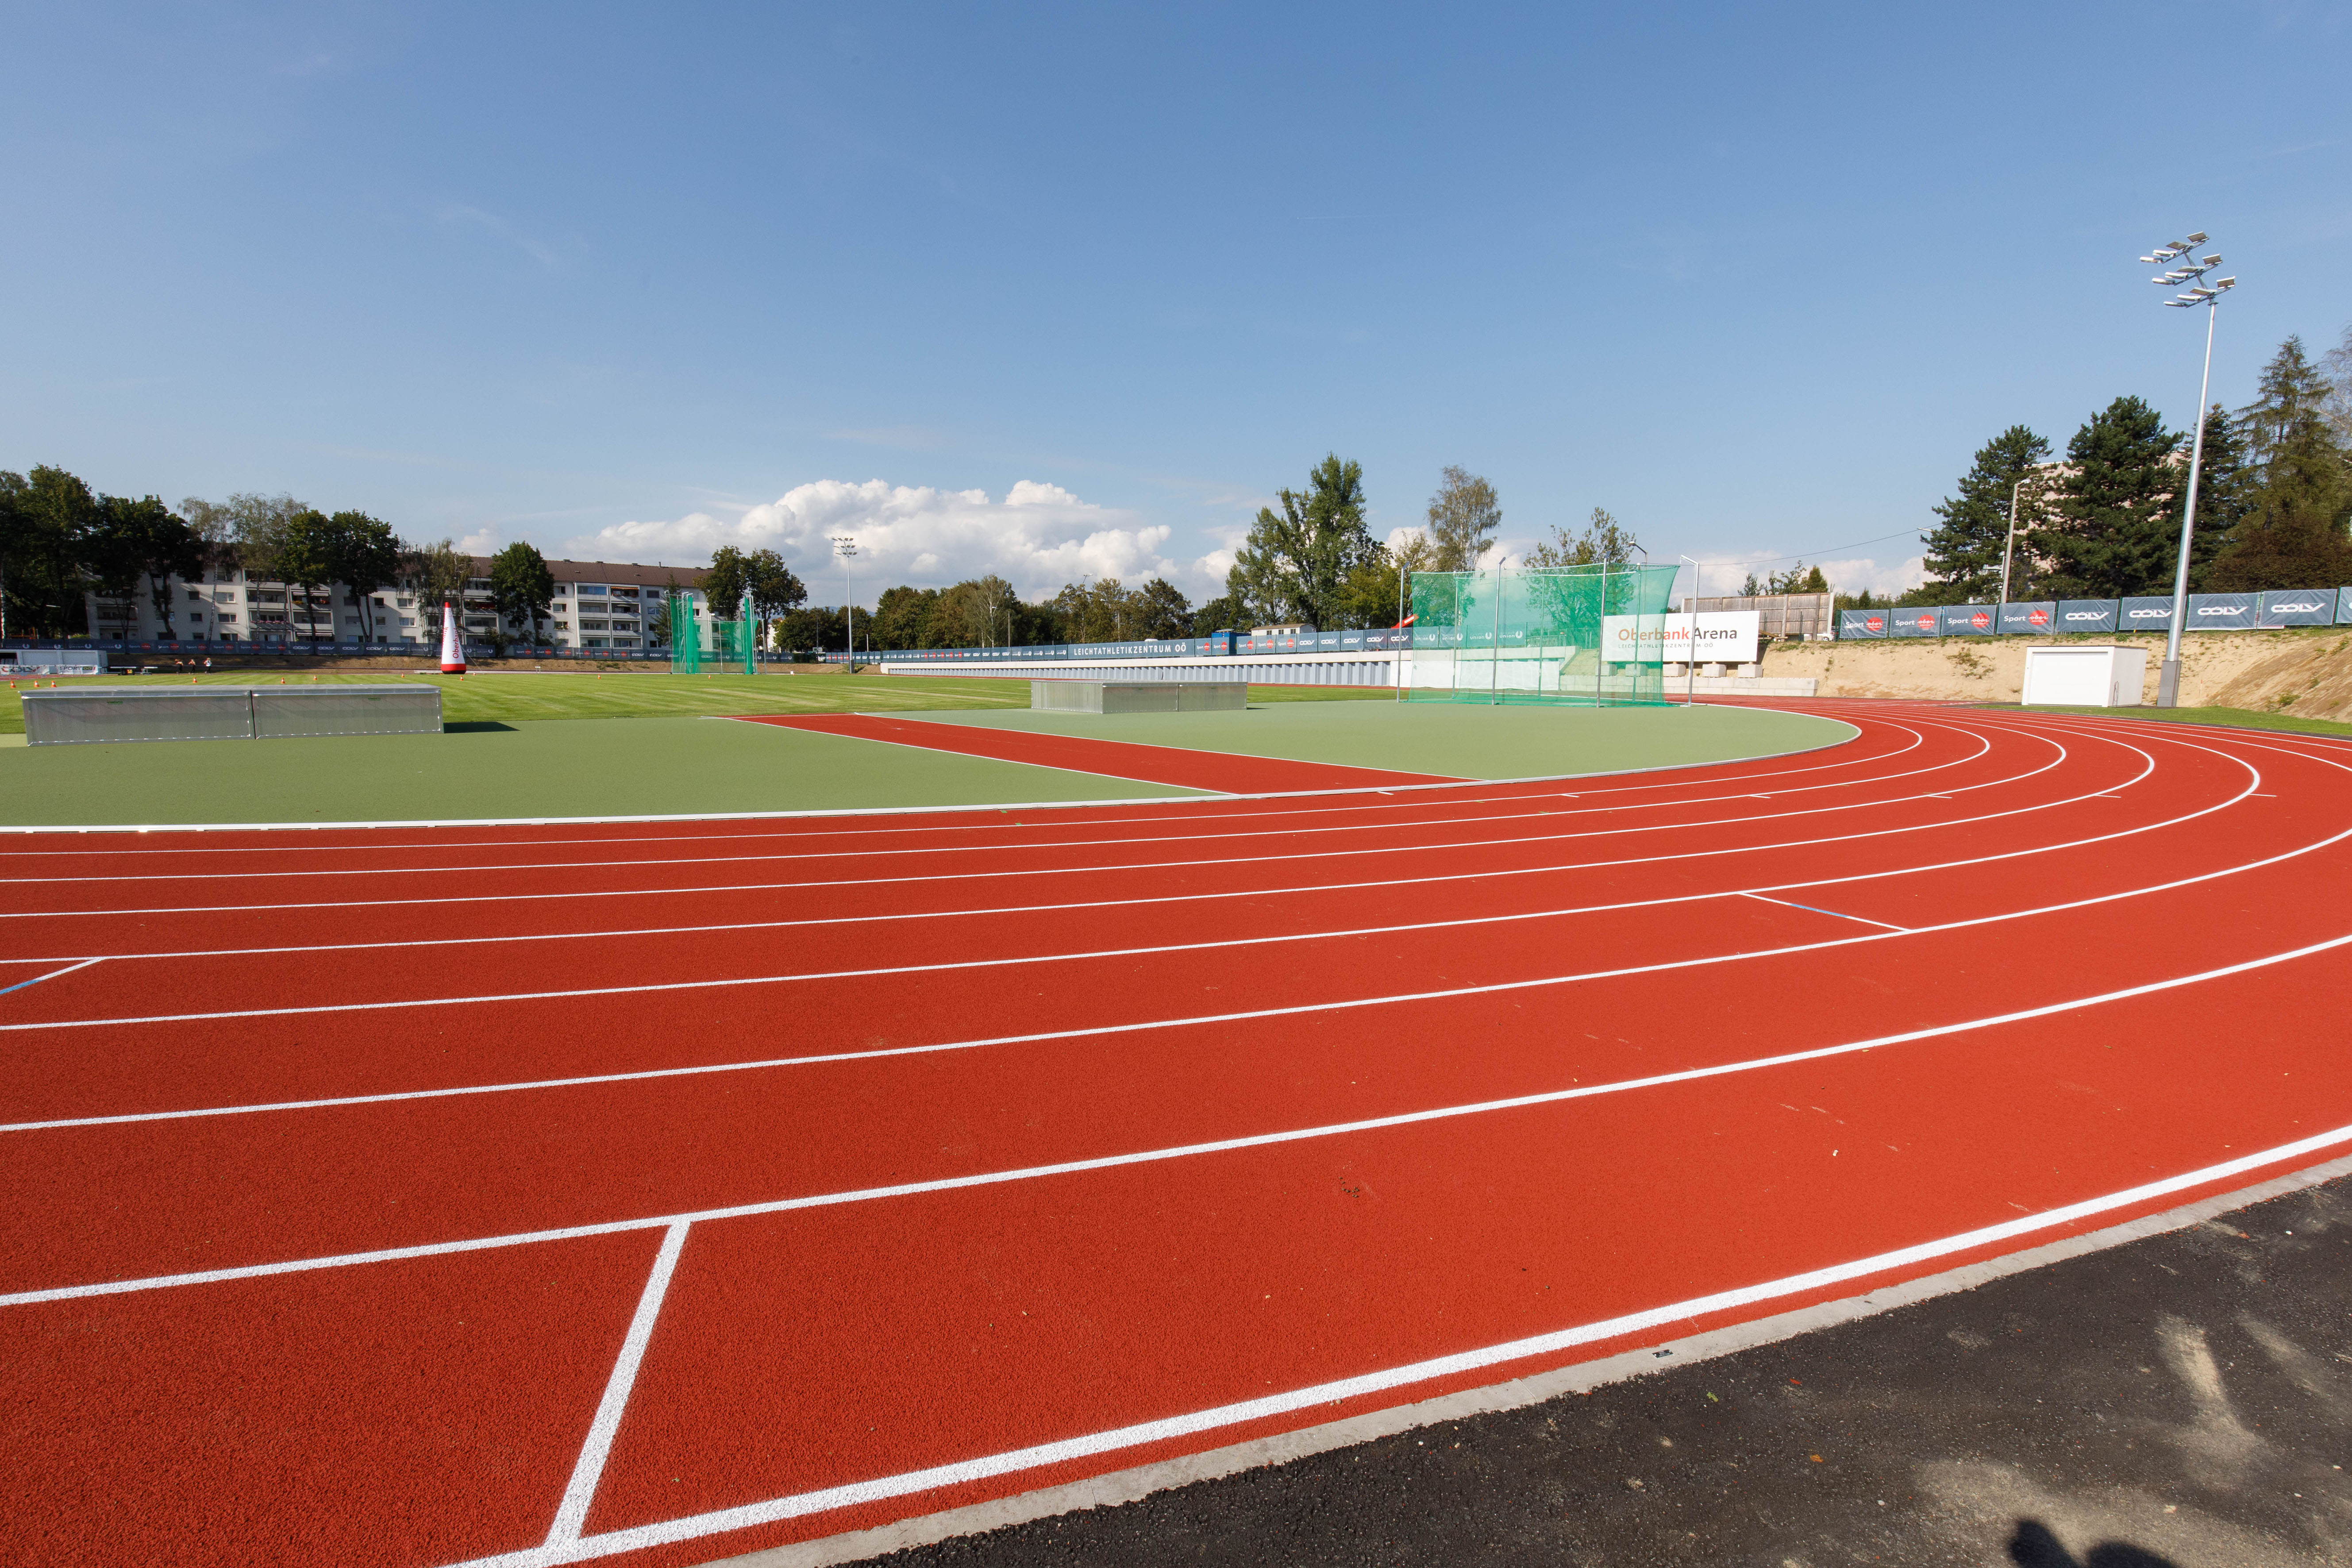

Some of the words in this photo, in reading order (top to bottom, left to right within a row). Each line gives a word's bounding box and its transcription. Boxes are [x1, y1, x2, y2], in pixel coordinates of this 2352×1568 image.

[1618, 627, 1690, 640] Oberbank
[1691, 627, 1737, 640] Arena
[1074, 645, 1171, 655] LEICHTATHLETIKZENTRUM
[1175, 643, 1186, 652] OÖ
